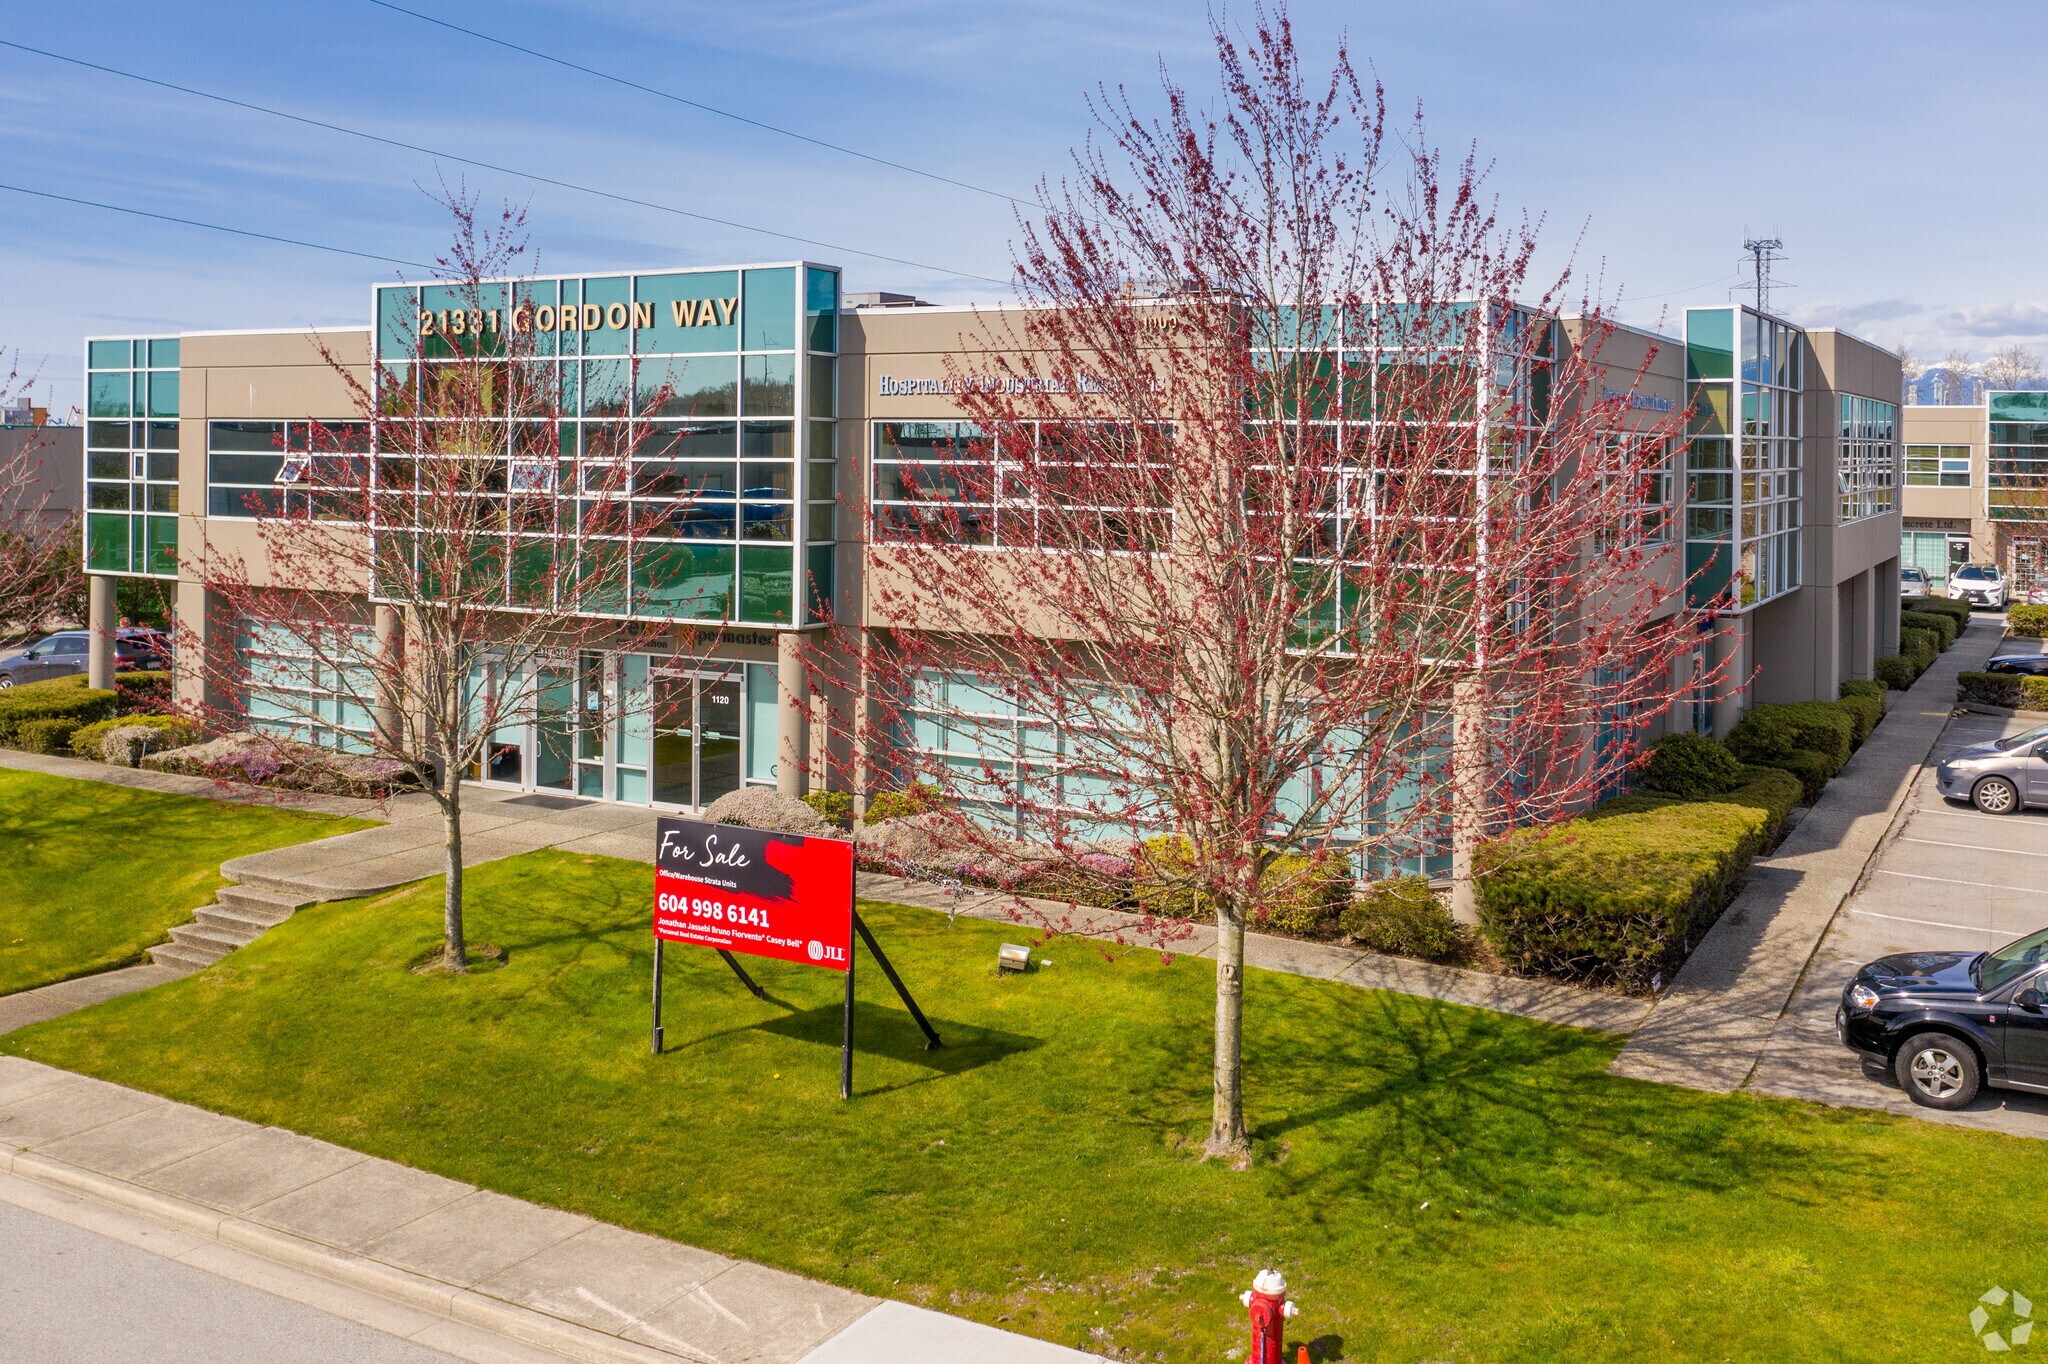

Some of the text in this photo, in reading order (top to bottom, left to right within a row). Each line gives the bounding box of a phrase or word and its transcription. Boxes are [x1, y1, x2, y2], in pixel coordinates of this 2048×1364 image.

[420, 297, 738, 336] 21331 GORDON WAY
[1937, 520, 1956, 529] Ltd.
[712, 695, 729, 704] 1120
[659, 830, 751, 867] For Sale
[659, 869, 737, 888] Office/Warehouse Strata Units
[658, 893, 770, 928] 604 998 6141
[658, 917, 687, 929] Jonathan
[687, 922, 711, 933] Jassebi
[711, 926, 731, 936] Bruno
[766, 935, 786, 947] Casey
[704, 935, 732, 945] Corporation
[823, 945, 845, 961] JLL
